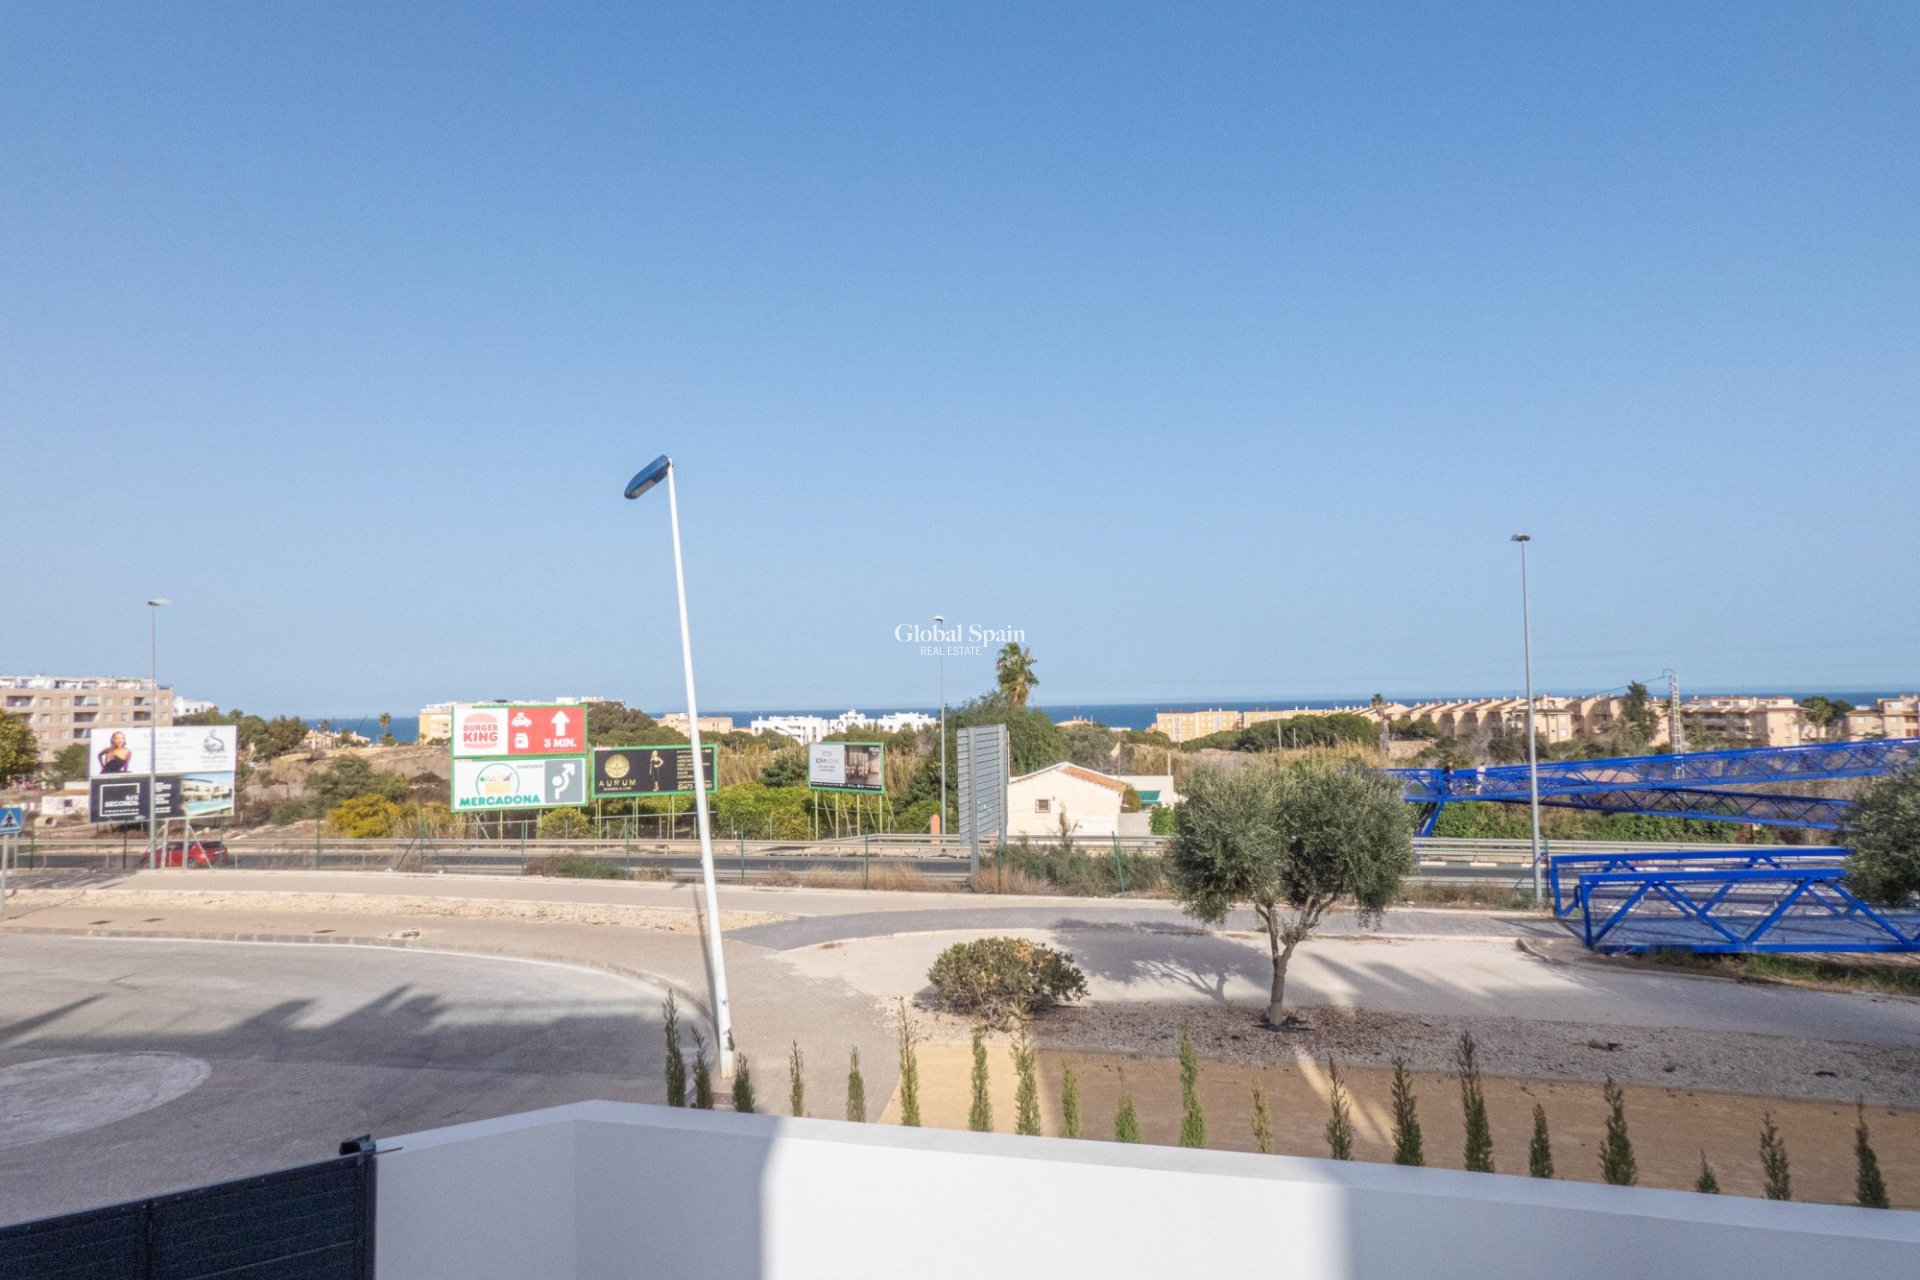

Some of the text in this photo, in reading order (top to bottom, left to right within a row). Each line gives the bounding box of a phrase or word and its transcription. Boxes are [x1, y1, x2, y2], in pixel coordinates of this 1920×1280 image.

[463, 724, 498, 732] BURGER
[463, 732, 498, 742] KING
[544, 738, 577, 748] 3 MIN.
[599, 779, 637, 787] AURUM
[459, 794, 541, 806] MERCADONA
